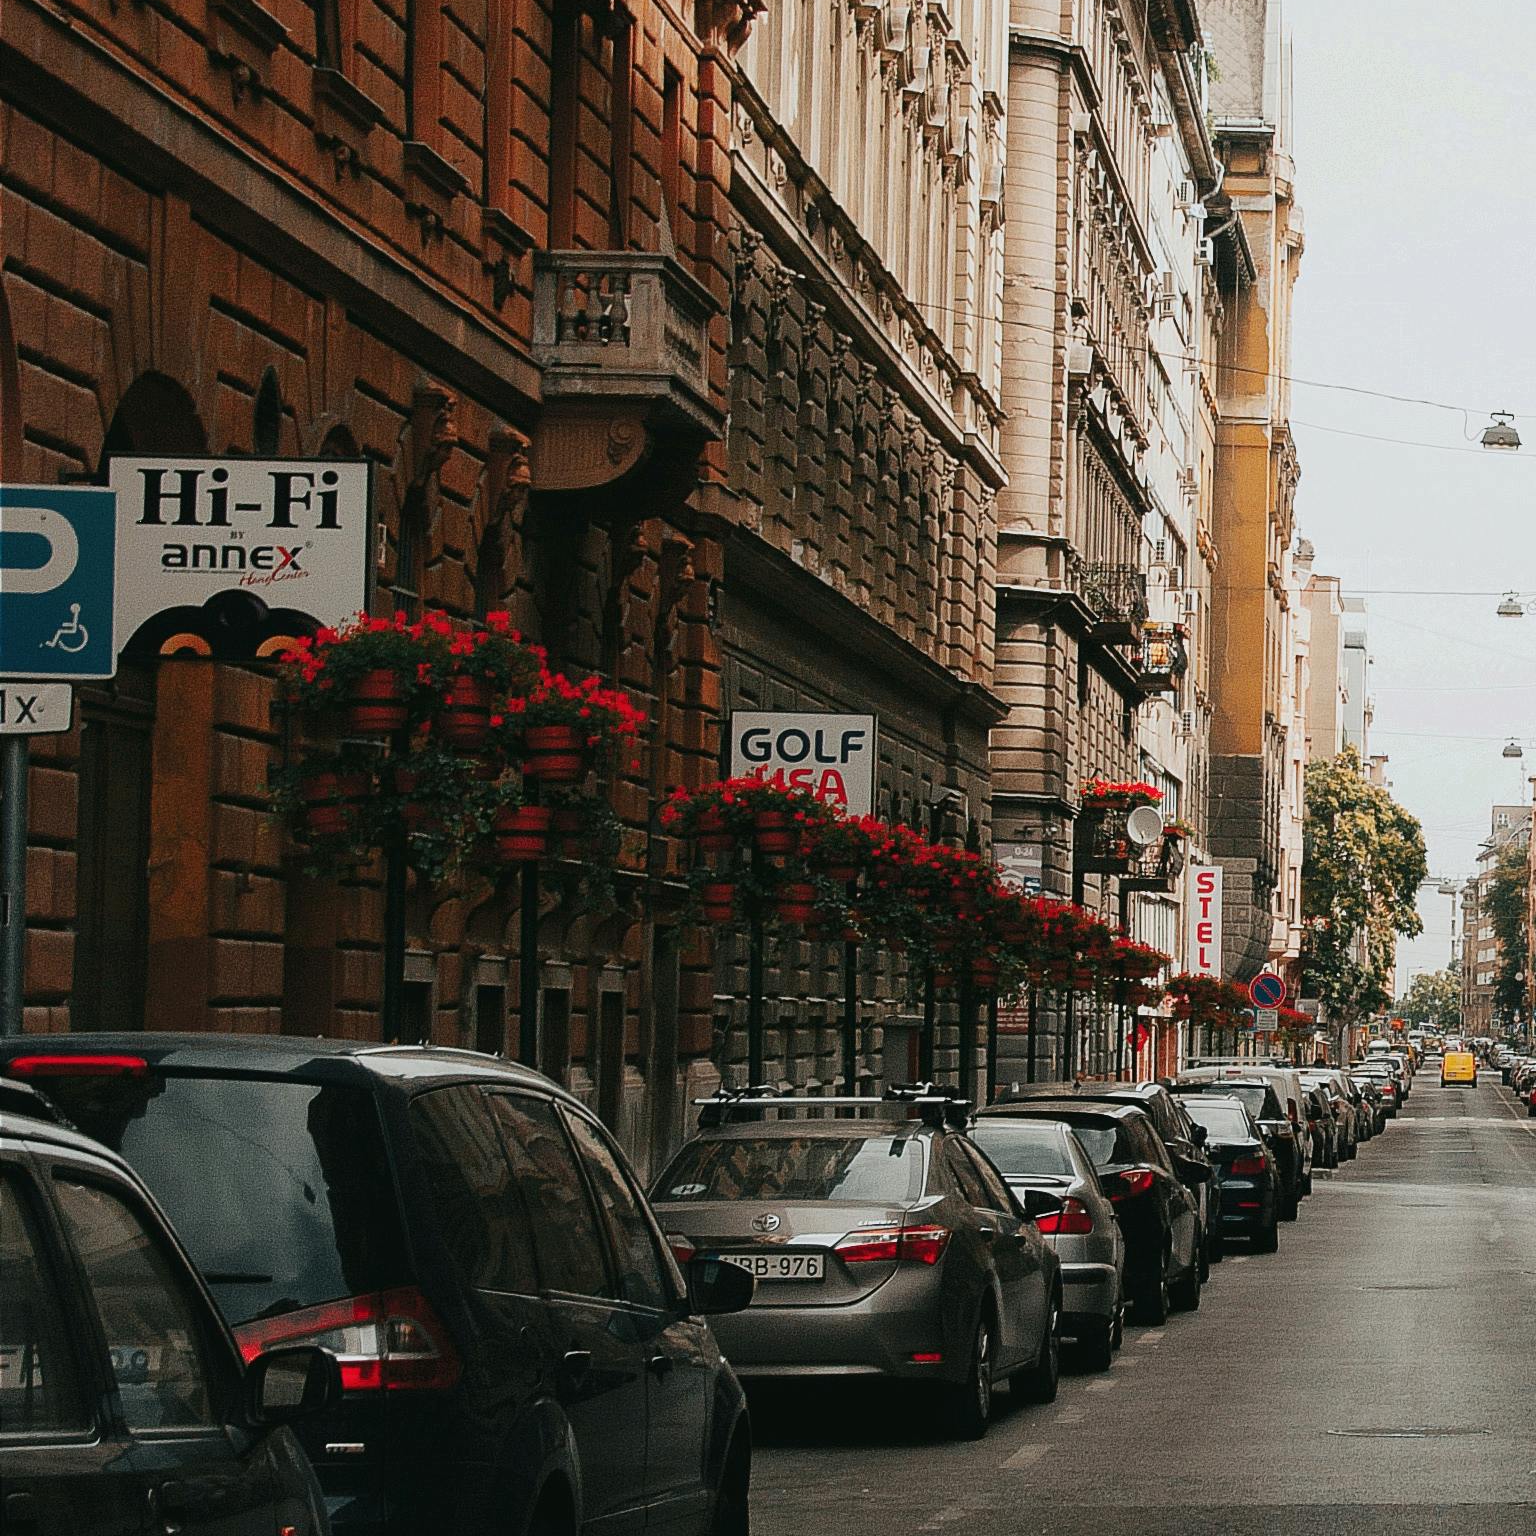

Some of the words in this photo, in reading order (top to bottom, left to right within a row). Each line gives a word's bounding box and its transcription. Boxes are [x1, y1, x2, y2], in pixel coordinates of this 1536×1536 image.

[136, 467, 342, 530] Hi-Fi
[230, 531, 245, 540] BY
[161, 543, 303, 570] annex
[740, 728, 865, 764] GOLF
[1196, 872, 1216, 978] STEL
[724, 1257, 818, 1276] BB-976
